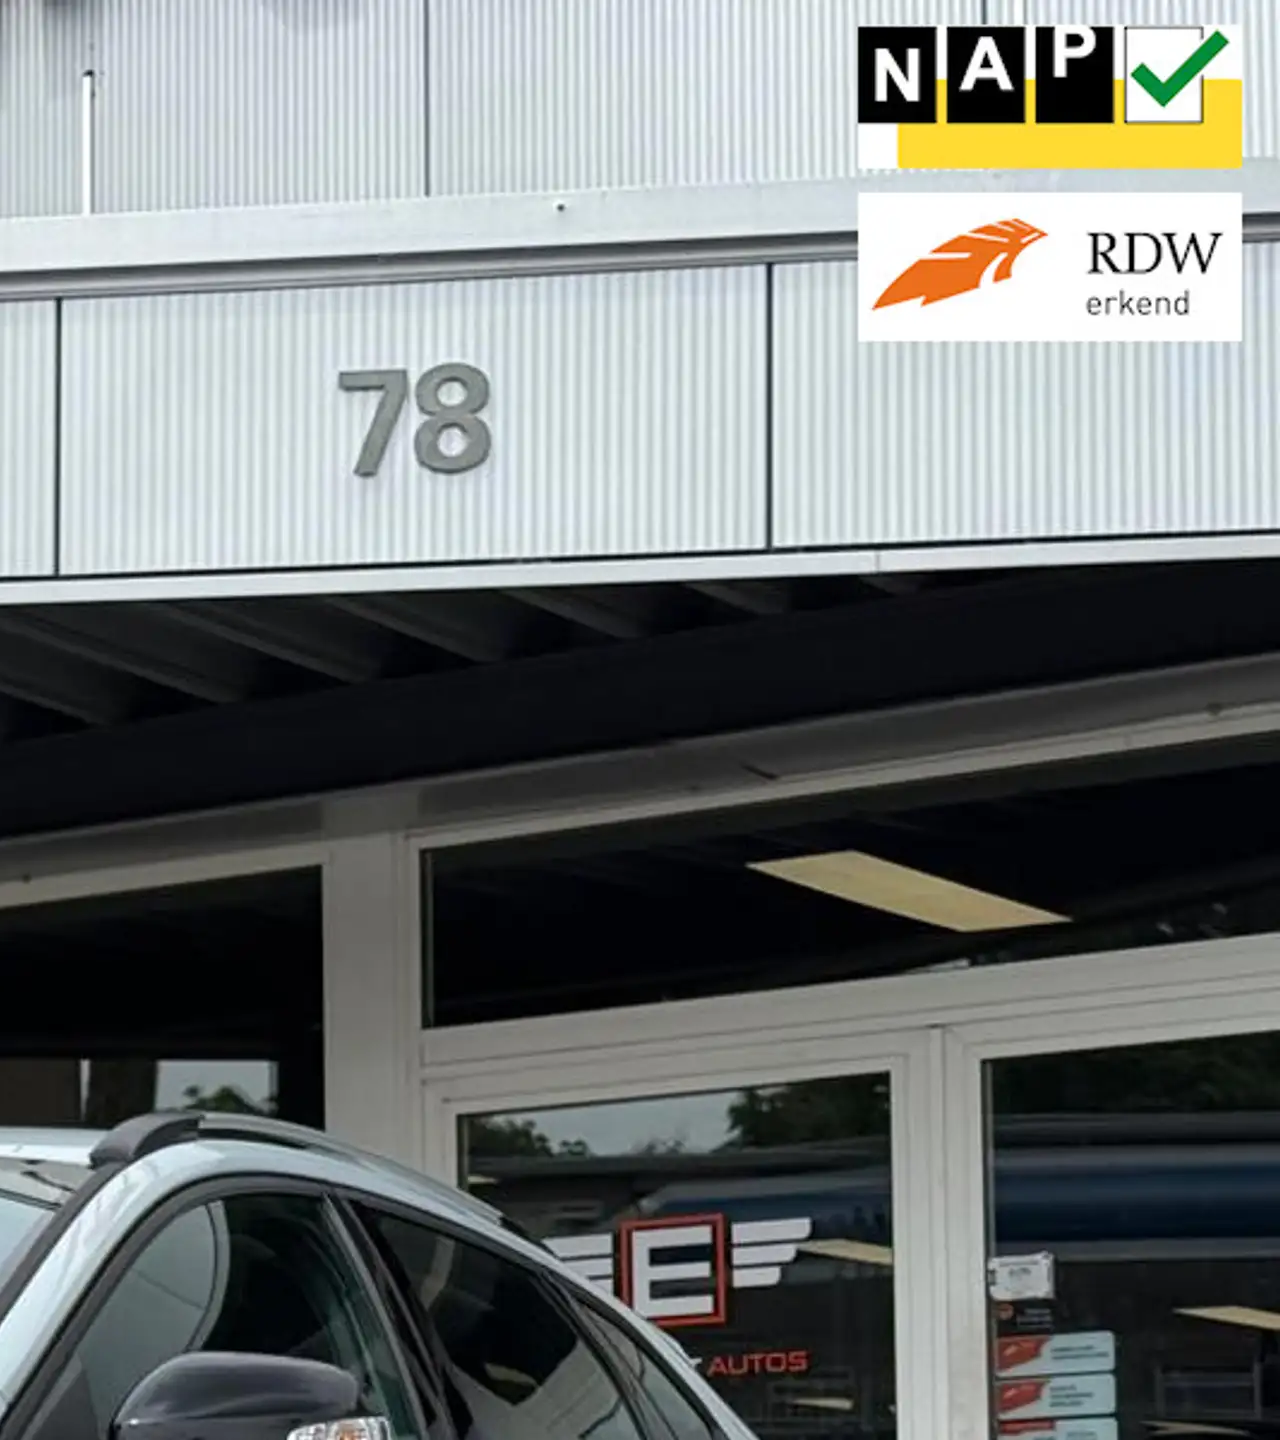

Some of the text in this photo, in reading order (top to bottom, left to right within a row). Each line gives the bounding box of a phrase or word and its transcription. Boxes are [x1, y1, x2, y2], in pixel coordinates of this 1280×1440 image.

[338, 362, 491, 478] 78
[631, 1224, 714, 1319] E
[707, 1350, 811, 1377] AUTOS
